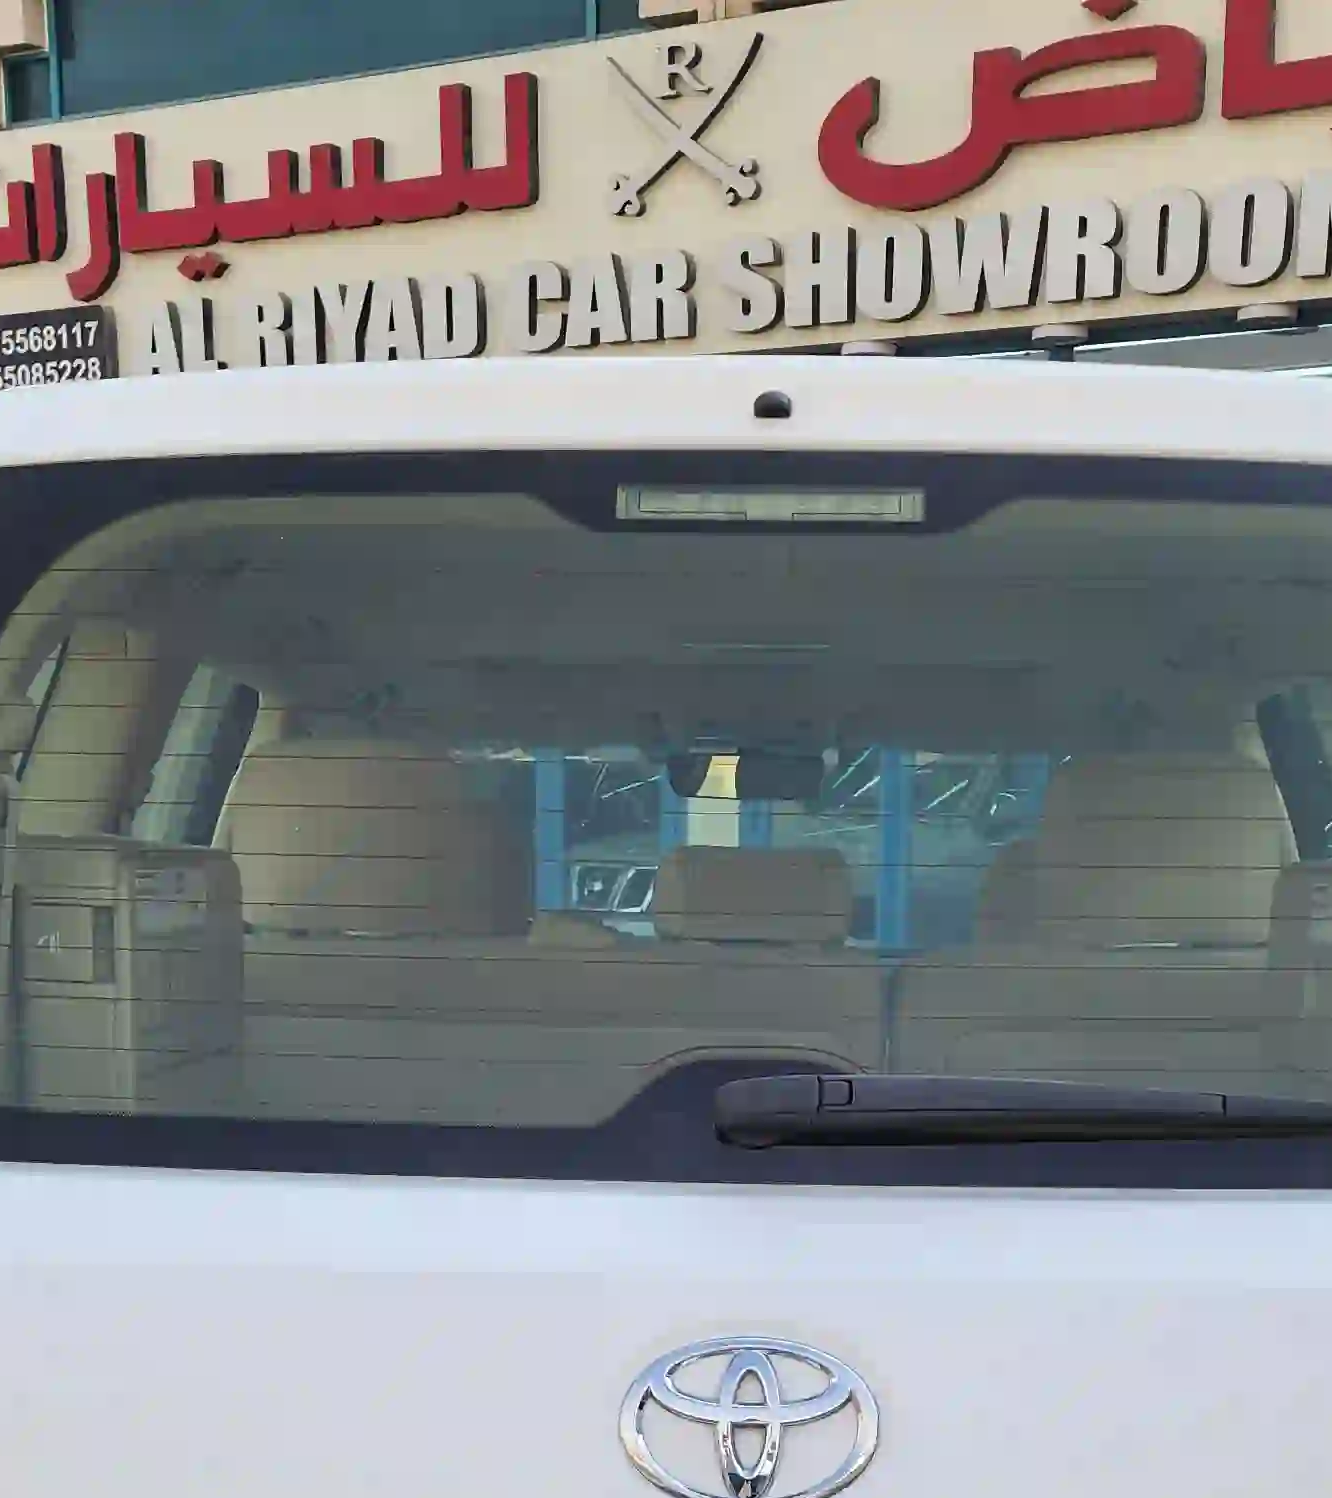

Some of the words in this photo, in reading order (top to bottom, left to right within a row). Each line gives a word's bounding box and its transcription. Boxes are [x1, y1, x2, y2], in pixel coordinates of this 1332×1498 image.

[655, 41, 712, 100] R
[143, 302, 230, 375] AL
[256, 274, 488, 368] RIYAD
[518, 250, 698, 353] CAR
